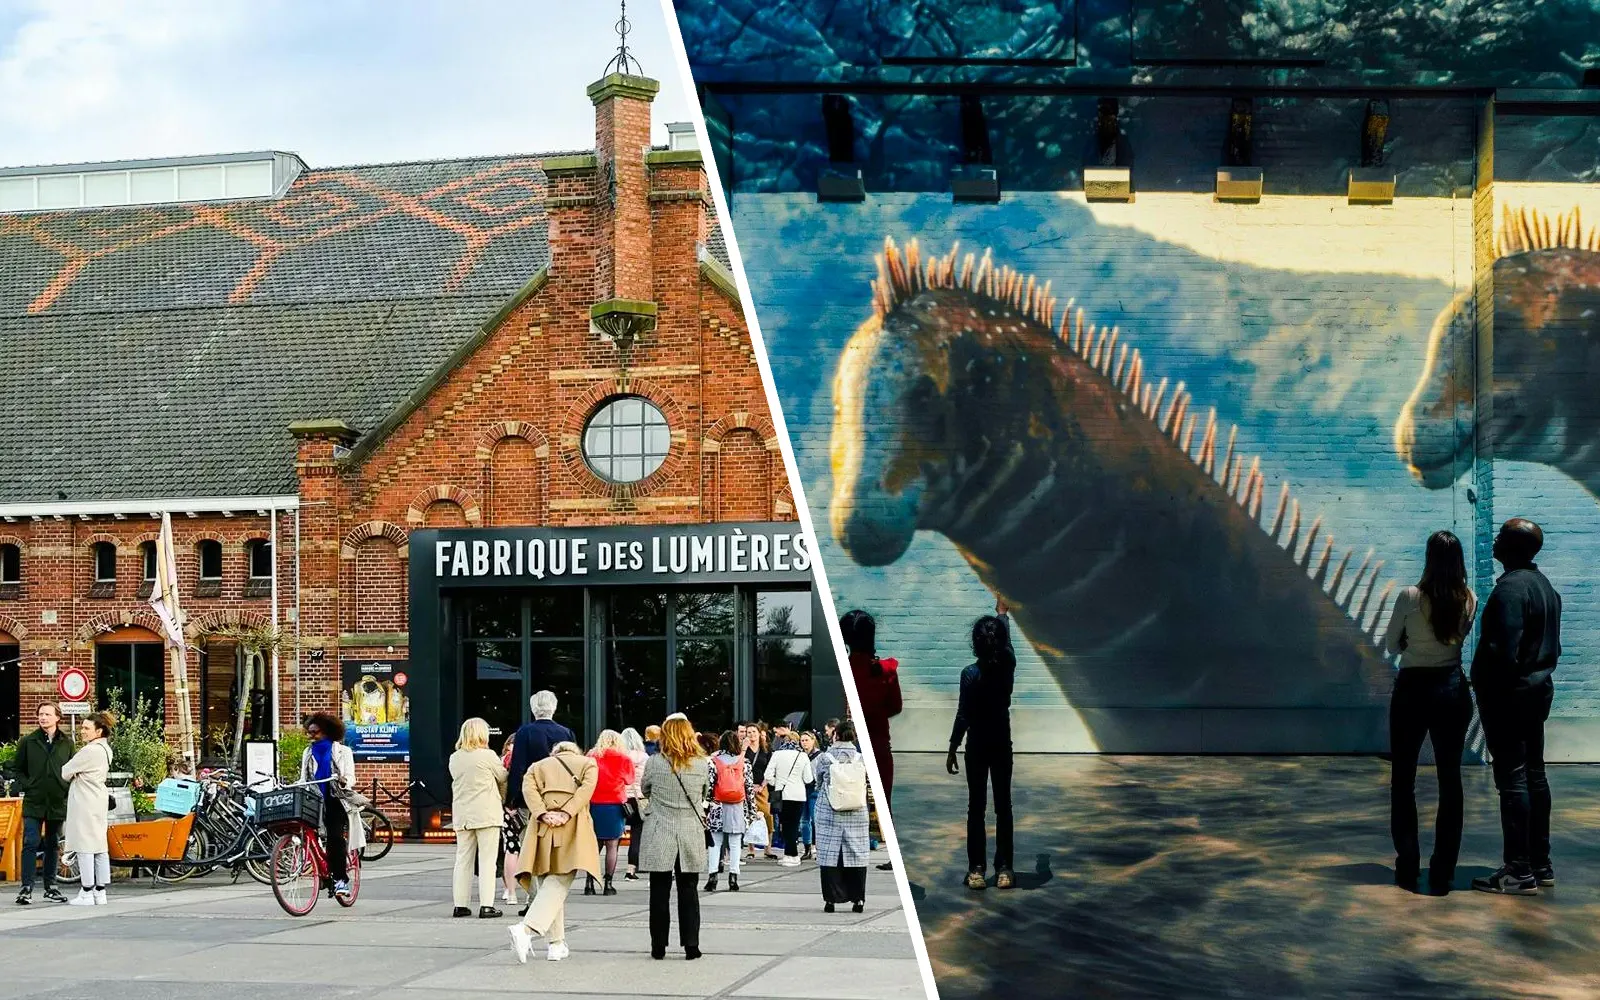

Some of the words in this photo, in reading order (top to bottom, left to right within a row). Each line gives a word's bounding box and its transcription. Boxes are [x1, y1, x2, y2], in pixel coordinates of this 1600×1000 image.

[436, 538, 588, 579] FABRIQUE
[598, 541, 643, 570] DES
[652, 528, 811, 573] LUMIÈRES
